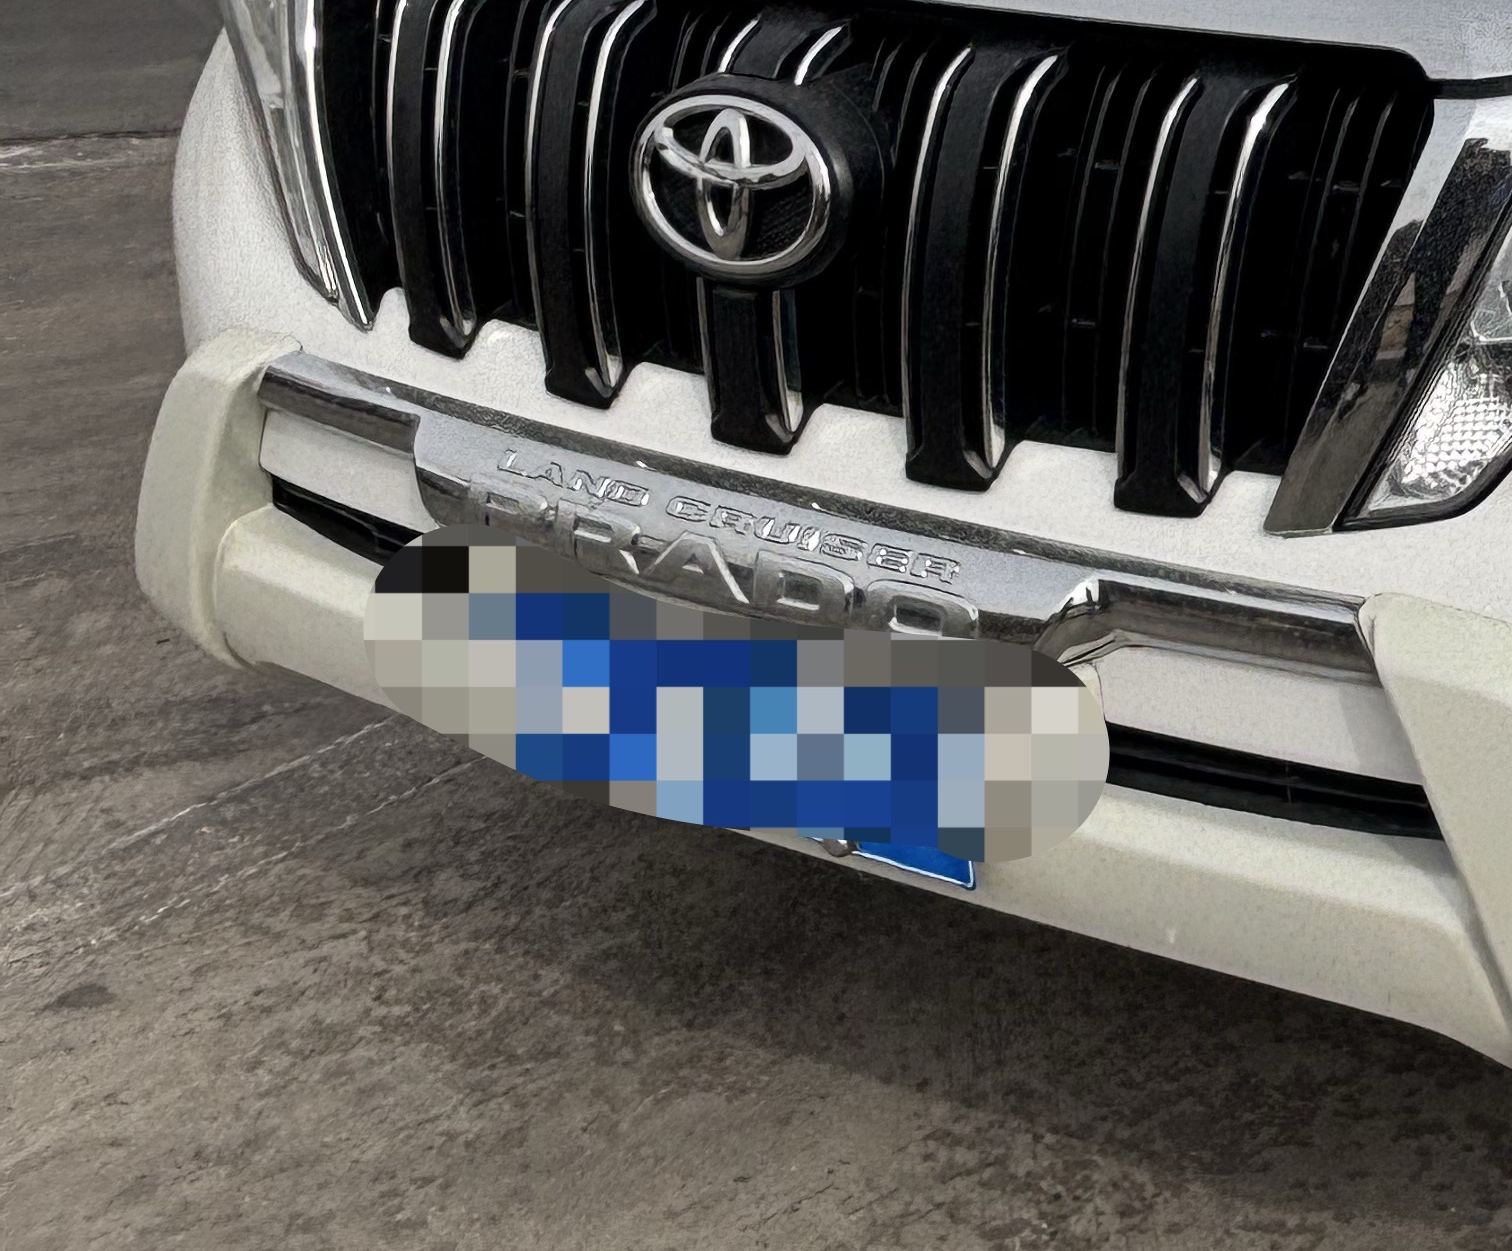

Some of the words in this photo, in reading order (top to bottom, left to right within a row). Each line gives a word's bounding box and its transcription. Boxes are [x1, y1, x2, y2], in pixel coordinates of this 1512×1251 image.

[470, 473, 980, 639] PRADO
[497, 448, 650, 508] LAND
[665, 494, 961, 585] CRUISER
